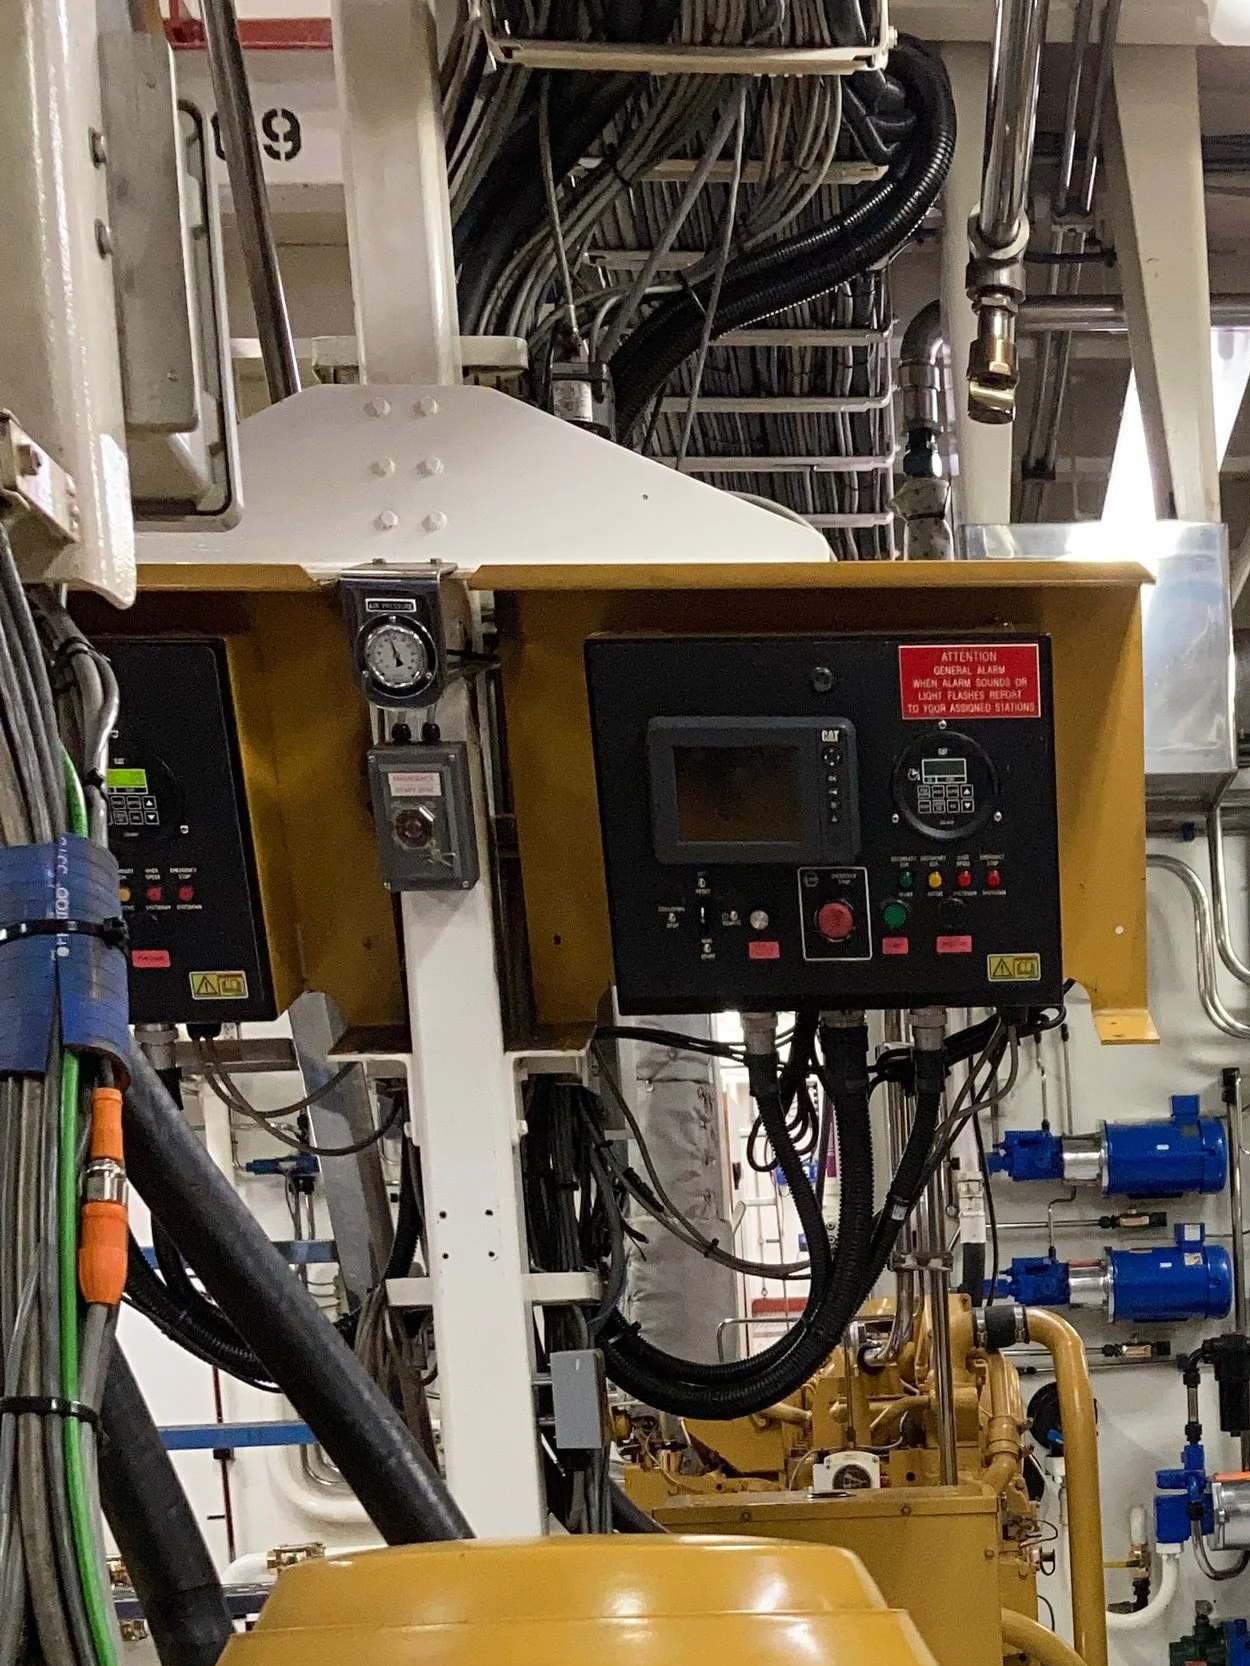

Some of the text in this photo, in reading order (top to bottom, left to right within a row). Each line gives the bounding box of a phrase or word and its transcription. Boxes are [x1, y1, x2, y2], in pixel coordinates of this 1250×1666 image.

[941, 651, 997, 662] ATTENTION
[933, 666, 1005, 675] GENERAL ALARM
[913, 678, 1028, 688] WHEN ALARM SOUNDS OR
[918, 690, 1022, 701] LIGHT FLASHES REPORT
[908, 702, 1035, 713] TO YOUR ASSIGNED STATIONS
[821, 730, 839, 742] CAT
